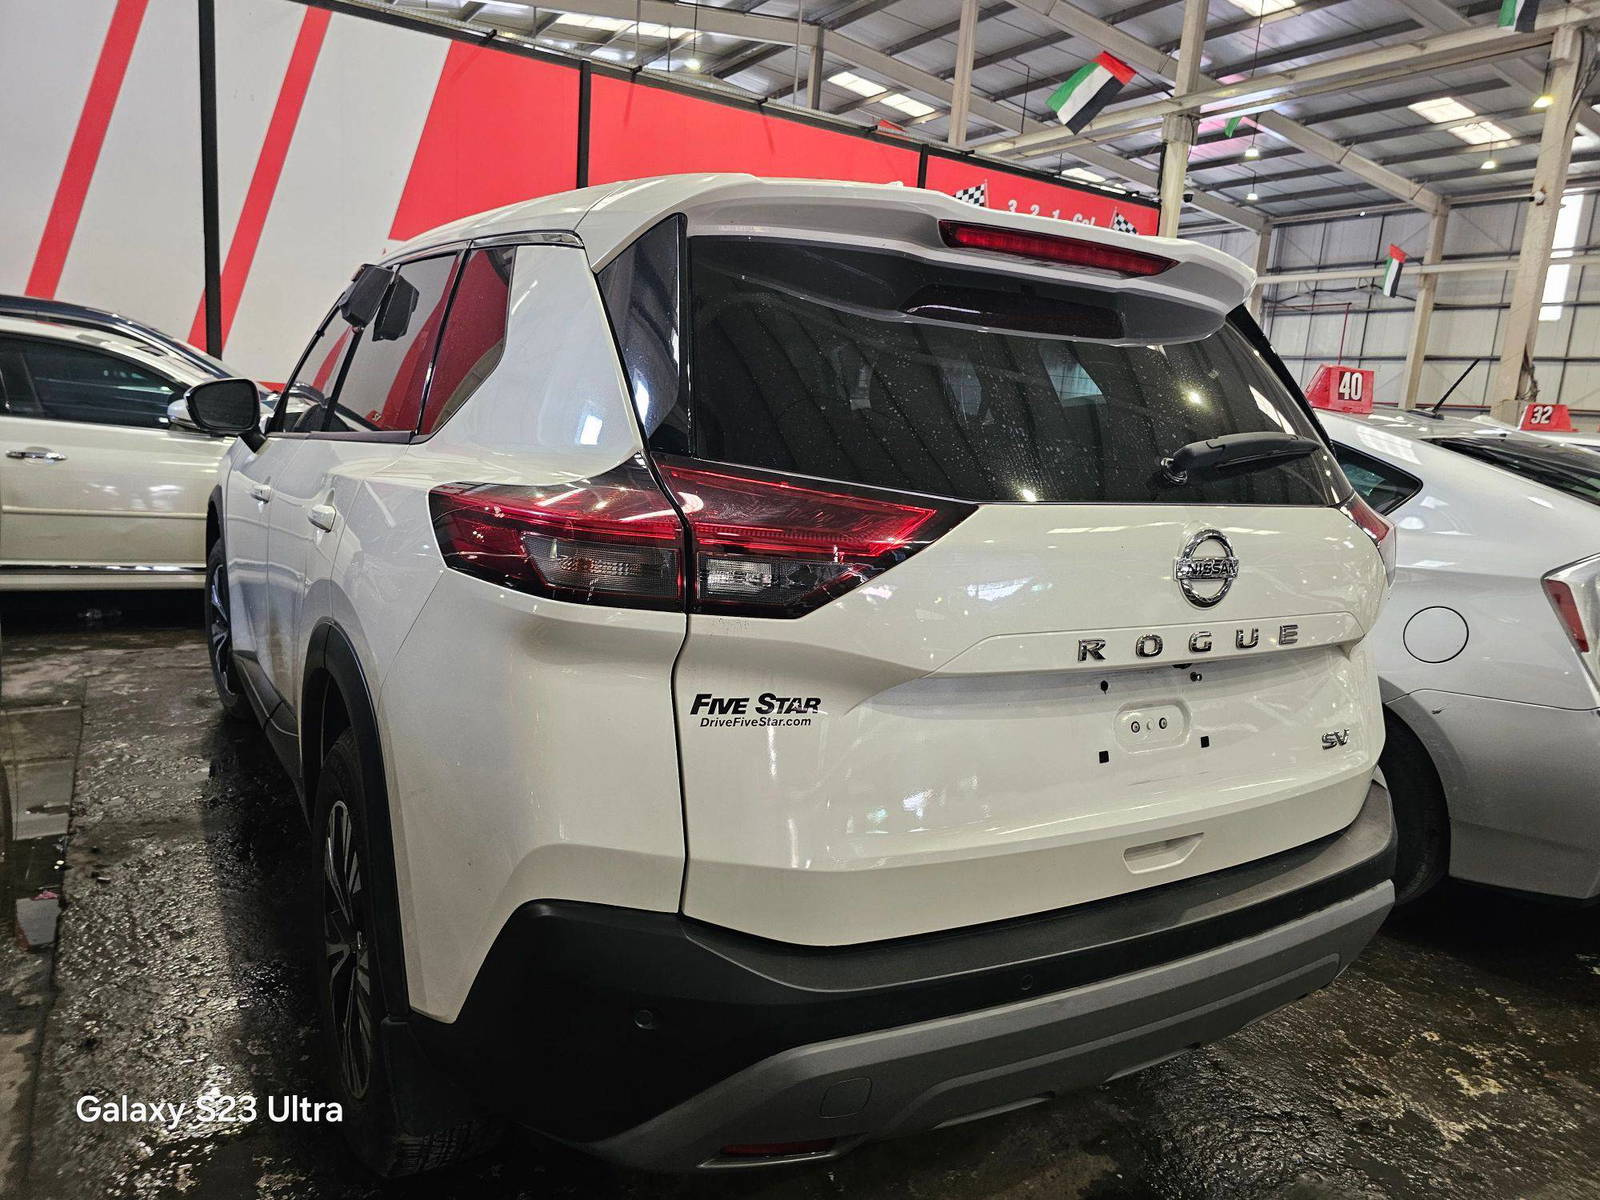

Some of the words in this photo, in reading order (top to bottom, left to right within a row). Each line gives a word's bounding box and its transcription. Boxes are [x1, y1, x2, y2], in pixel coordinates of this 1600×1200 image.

[1339, 372, 1363, 400] 40
[1531, 405, 1553, 424] 32
[1183, 560, 1237, 576] NISSAN
[1078, 624, 1299, 662] ROGUE
[690, 693, 750, 715] FIVE
[755, 693, 821, 714] STAR
[700, 717, 811, 728] DriveFiveStar.com
[1321, 729, 1350, 750] SV
